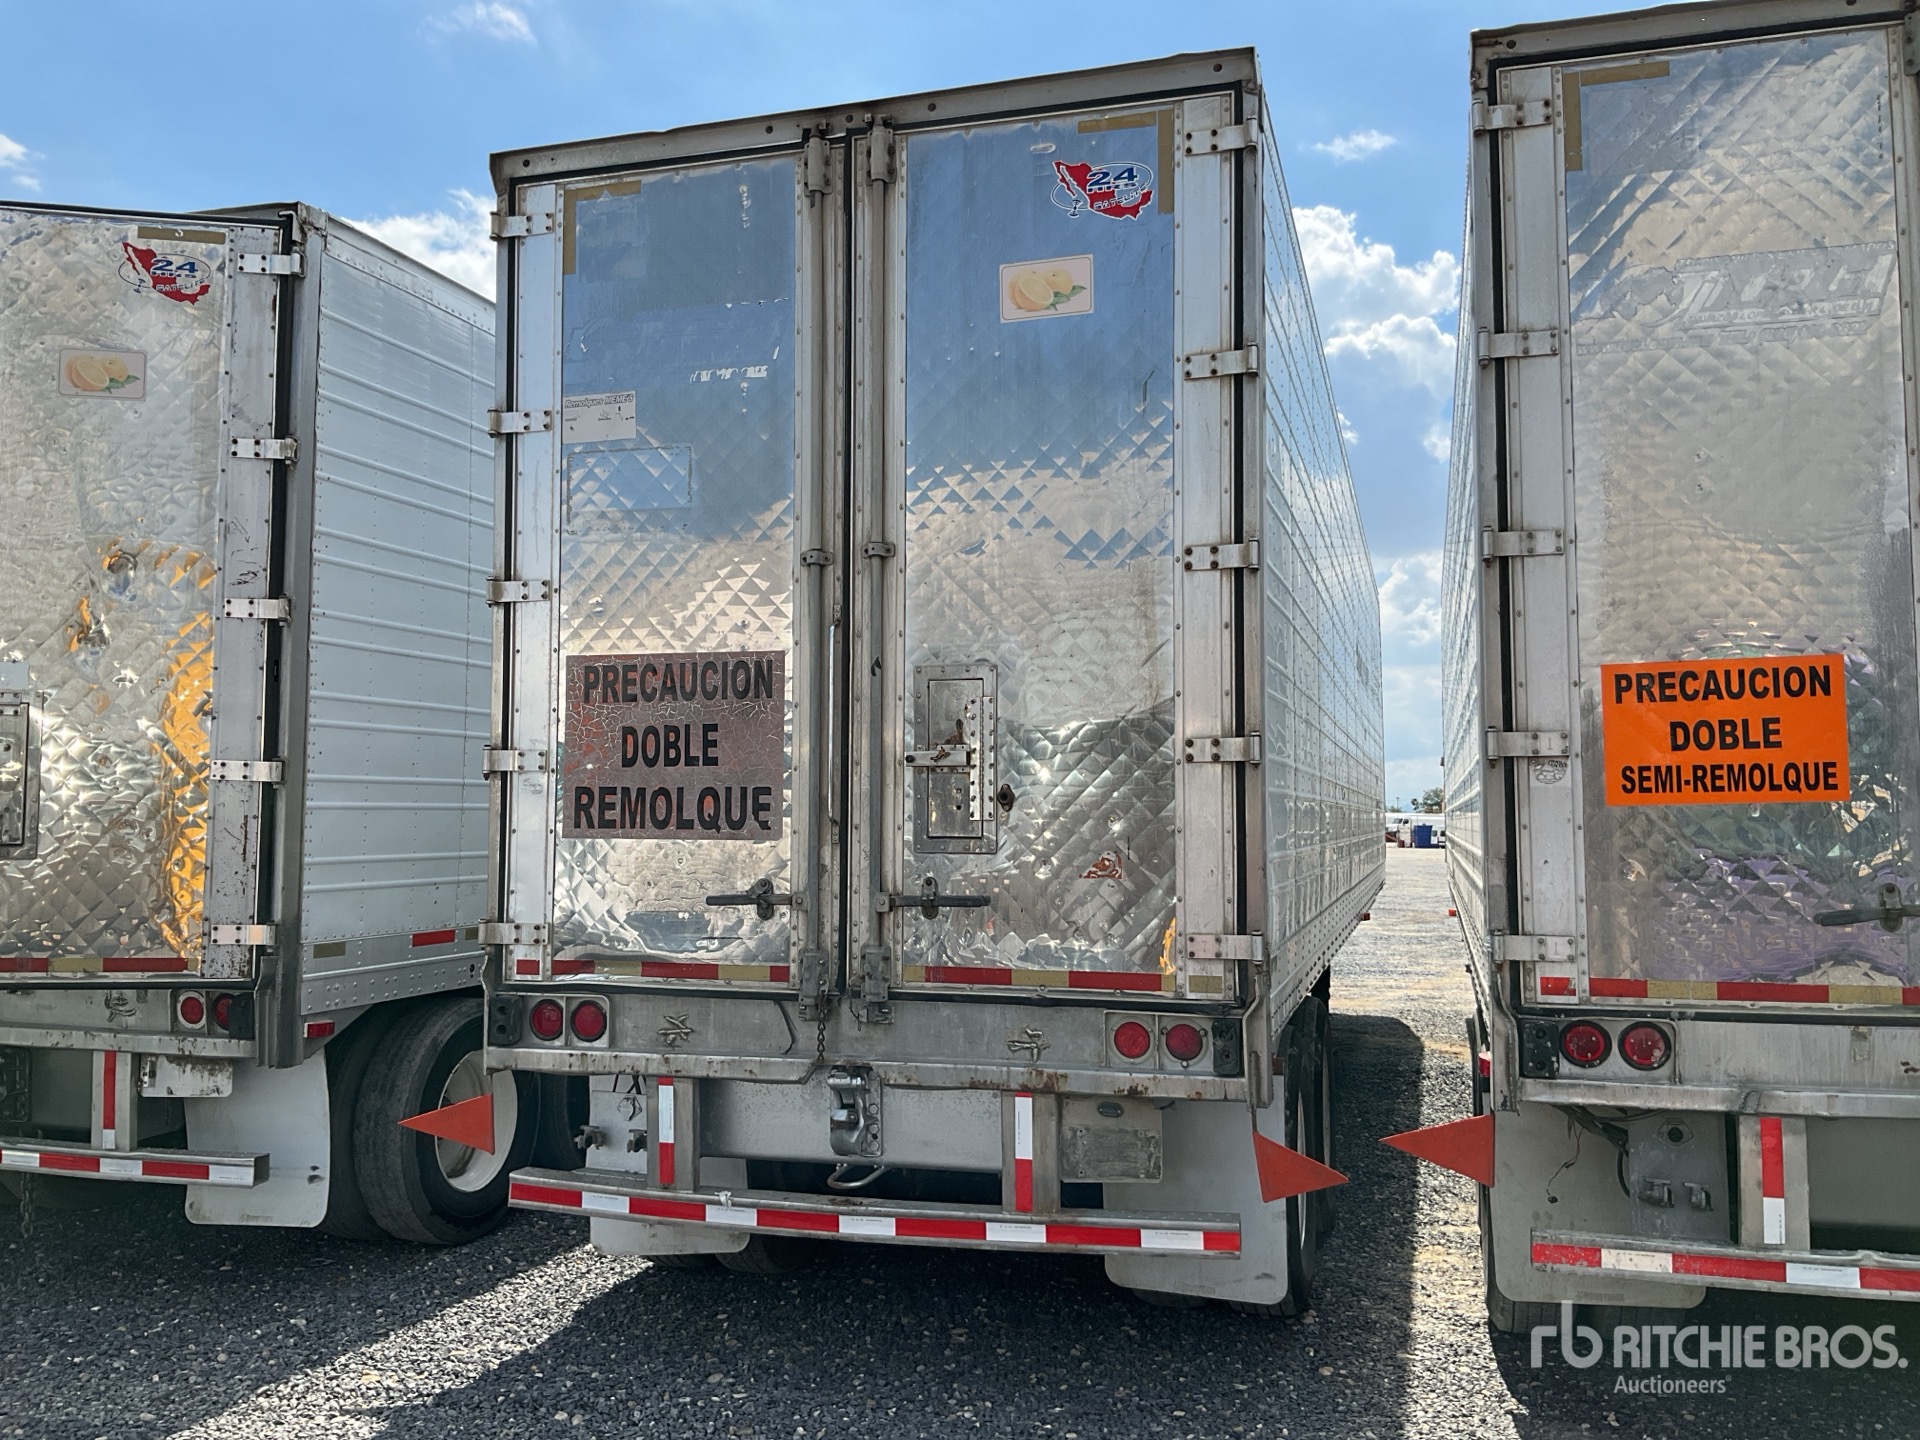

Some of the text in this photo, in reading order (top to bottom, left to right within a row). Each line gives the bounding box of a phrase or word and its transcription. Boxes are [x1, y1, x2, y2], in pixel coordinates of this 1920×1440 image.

[1087, 166, 1138, 187] 24
[151, 258, 198, 274] 24
[565, 397, 604, 408] Remolques
[584, 660, 773, 703] PRECAUCION
[1615, 665, 1831, 704] PRECAUCION
[621, 723, 719, 768] DOBLE
[1670, 717, 1783, 752] DOBLE
[1621, 761, 1838, 794] SEMI-REMOLQUE
[573, 786, 772, 834] REMOLQUE
